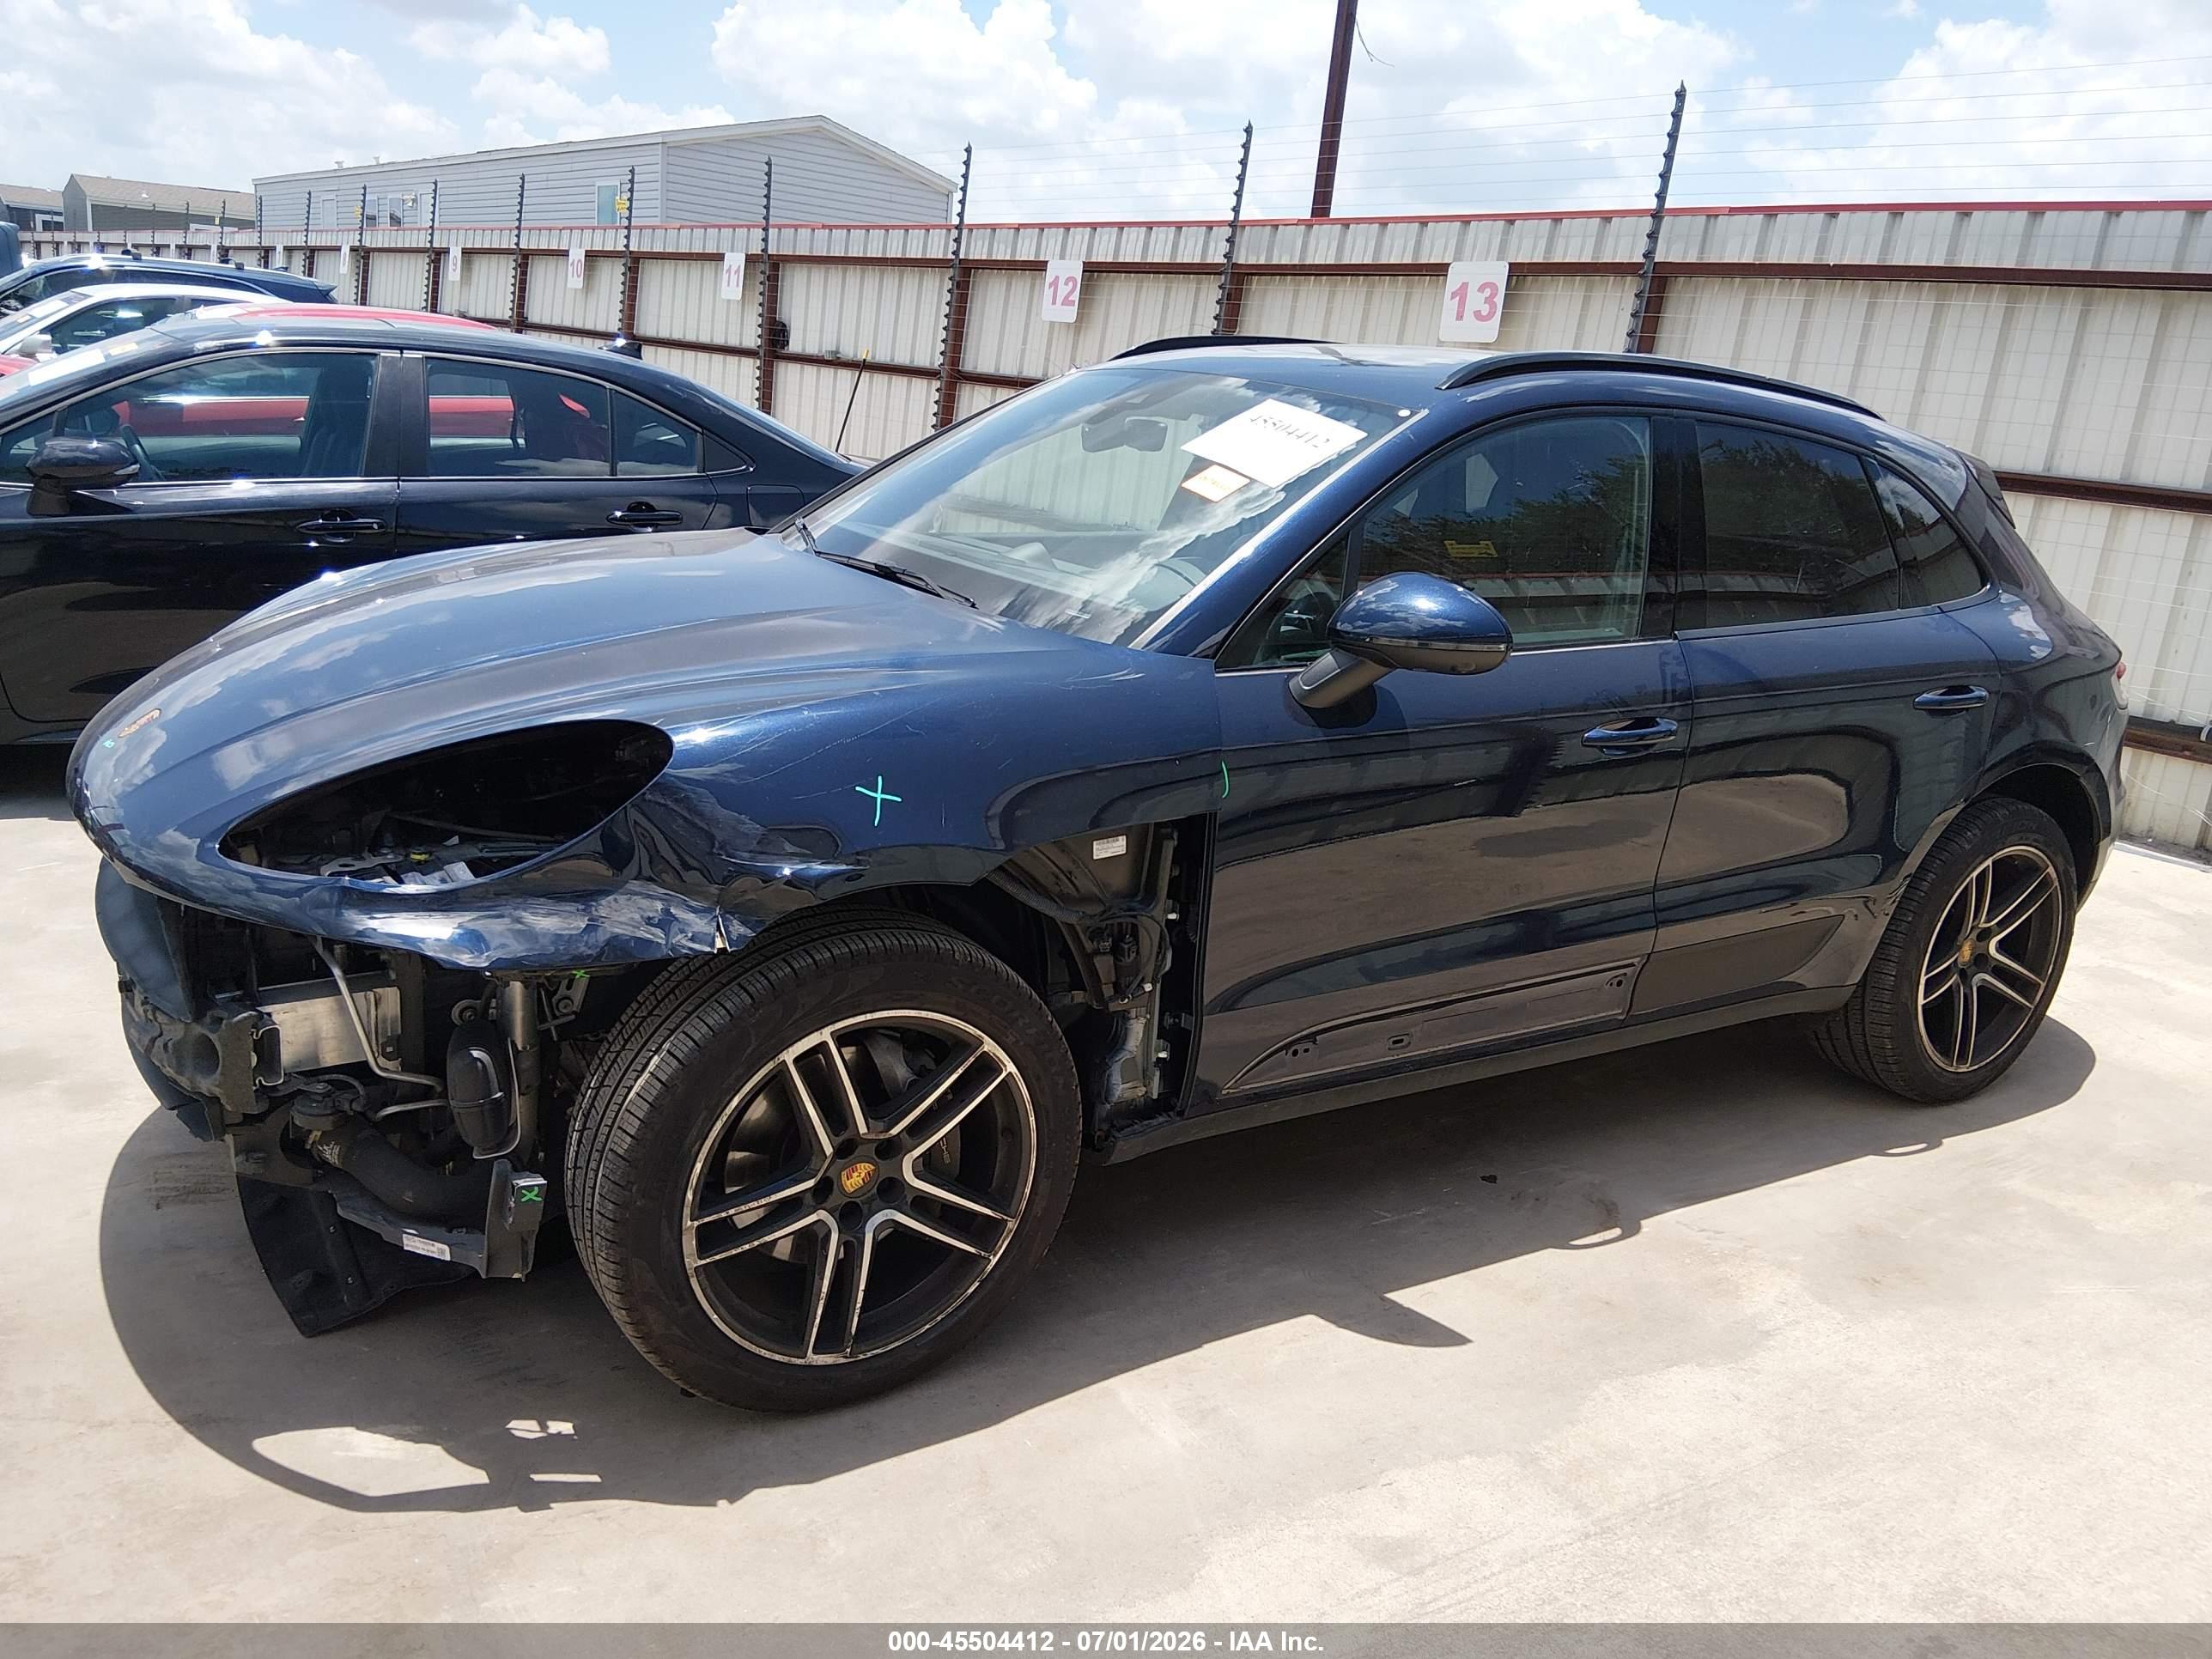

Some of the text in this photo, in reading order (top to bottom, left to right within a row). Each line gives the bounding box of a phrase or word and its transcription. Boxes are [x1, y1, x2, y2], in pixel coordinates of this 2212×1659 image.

[452, 256, 458, 272] 9
[569, 258, 583, 278] 10
[725, 264, 741, 289] 11
[1048, 276, 1078, 307] 12
[1449, 282, 1498, 322] 13
